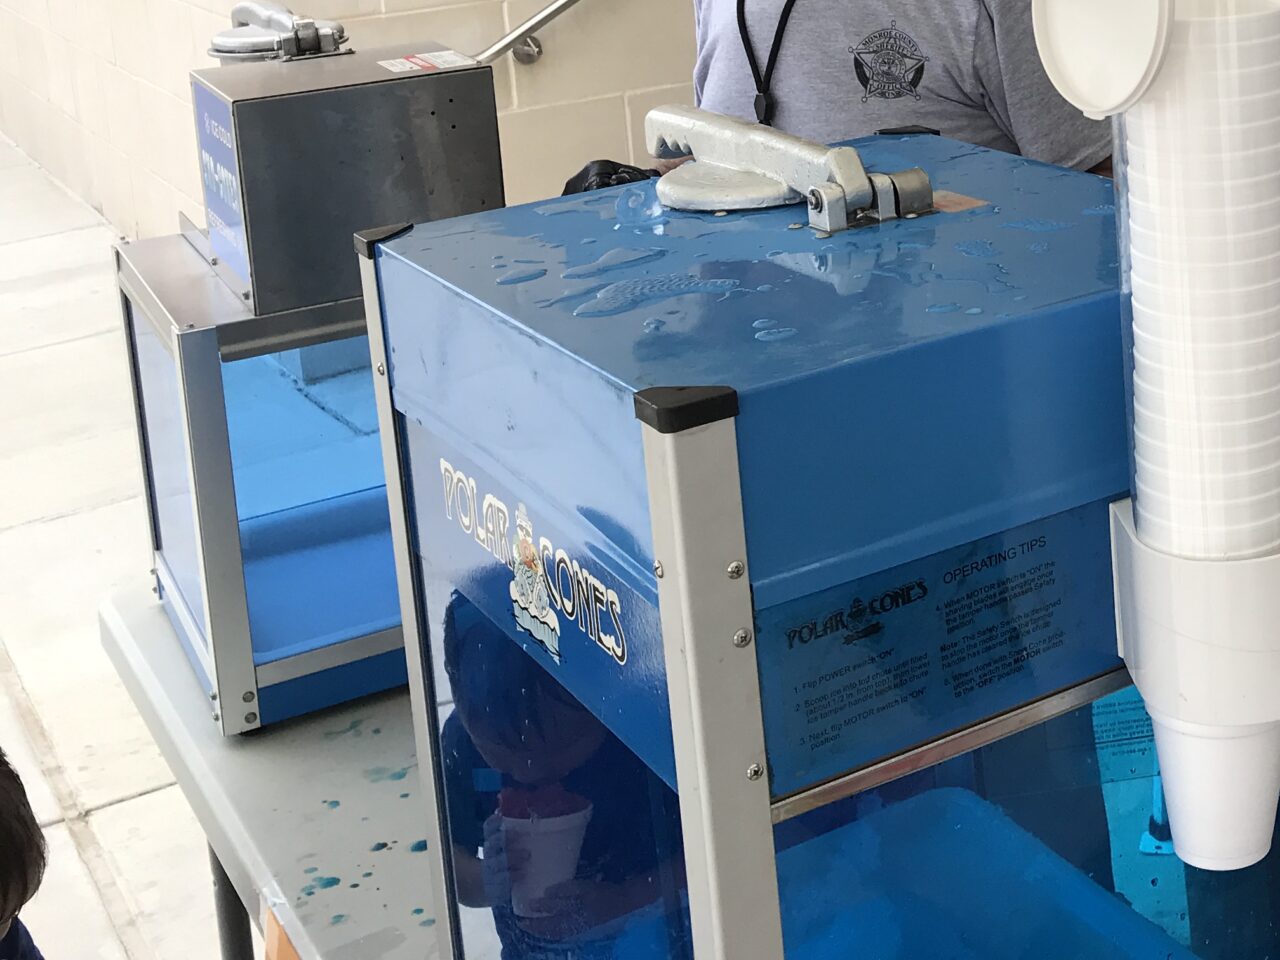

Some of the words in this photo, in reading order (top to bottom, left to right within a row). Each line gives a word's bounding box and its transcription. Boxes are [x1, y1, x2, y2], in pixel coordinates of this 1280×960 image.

[862, 31, 892, 46] MONROE
[895, 31, 918, 52] COUNTY
[440, 458, 514, 573] POLAR
[539, 536, 627, 666] CONES
[943, 547, 1017, 584] OPERATING
[1018, 536, 1047, 556] TIPS
[944, 596, 964, 608] When
[966, 583, 995, 599] MOTOR
[945, 602, 972, 618] shaving
[974, 593, 995, 605] blades
[1010, 578, 1035, 592] engage
[946, 616, 956, 625] the
[1033, 577, 1054, 590] Safety
[785, 607, 849, 649] POLAR
[868, 578, 928, 616] CONES
[962, 633, 974, 642] The
[977, 624, 998, 638] Safety
[1000, 614, 1022, 627] Switch
[950, 647, 965, 658] stop
[966, 642, 977, 651] the
[978, 666, 1000, 679] switch
[1014, 648, 1040, 664] MOTOR
[818, 666, 850, 683] POWER
[952, 668, 972, 681] When
[974, 660, 991, 672] done
[804, 693, 827, 708] Scoop
[857, 684, 872, 695] from
[844, 708, 874, 727] MOTOR
[876, 698, 898, 713] switch
